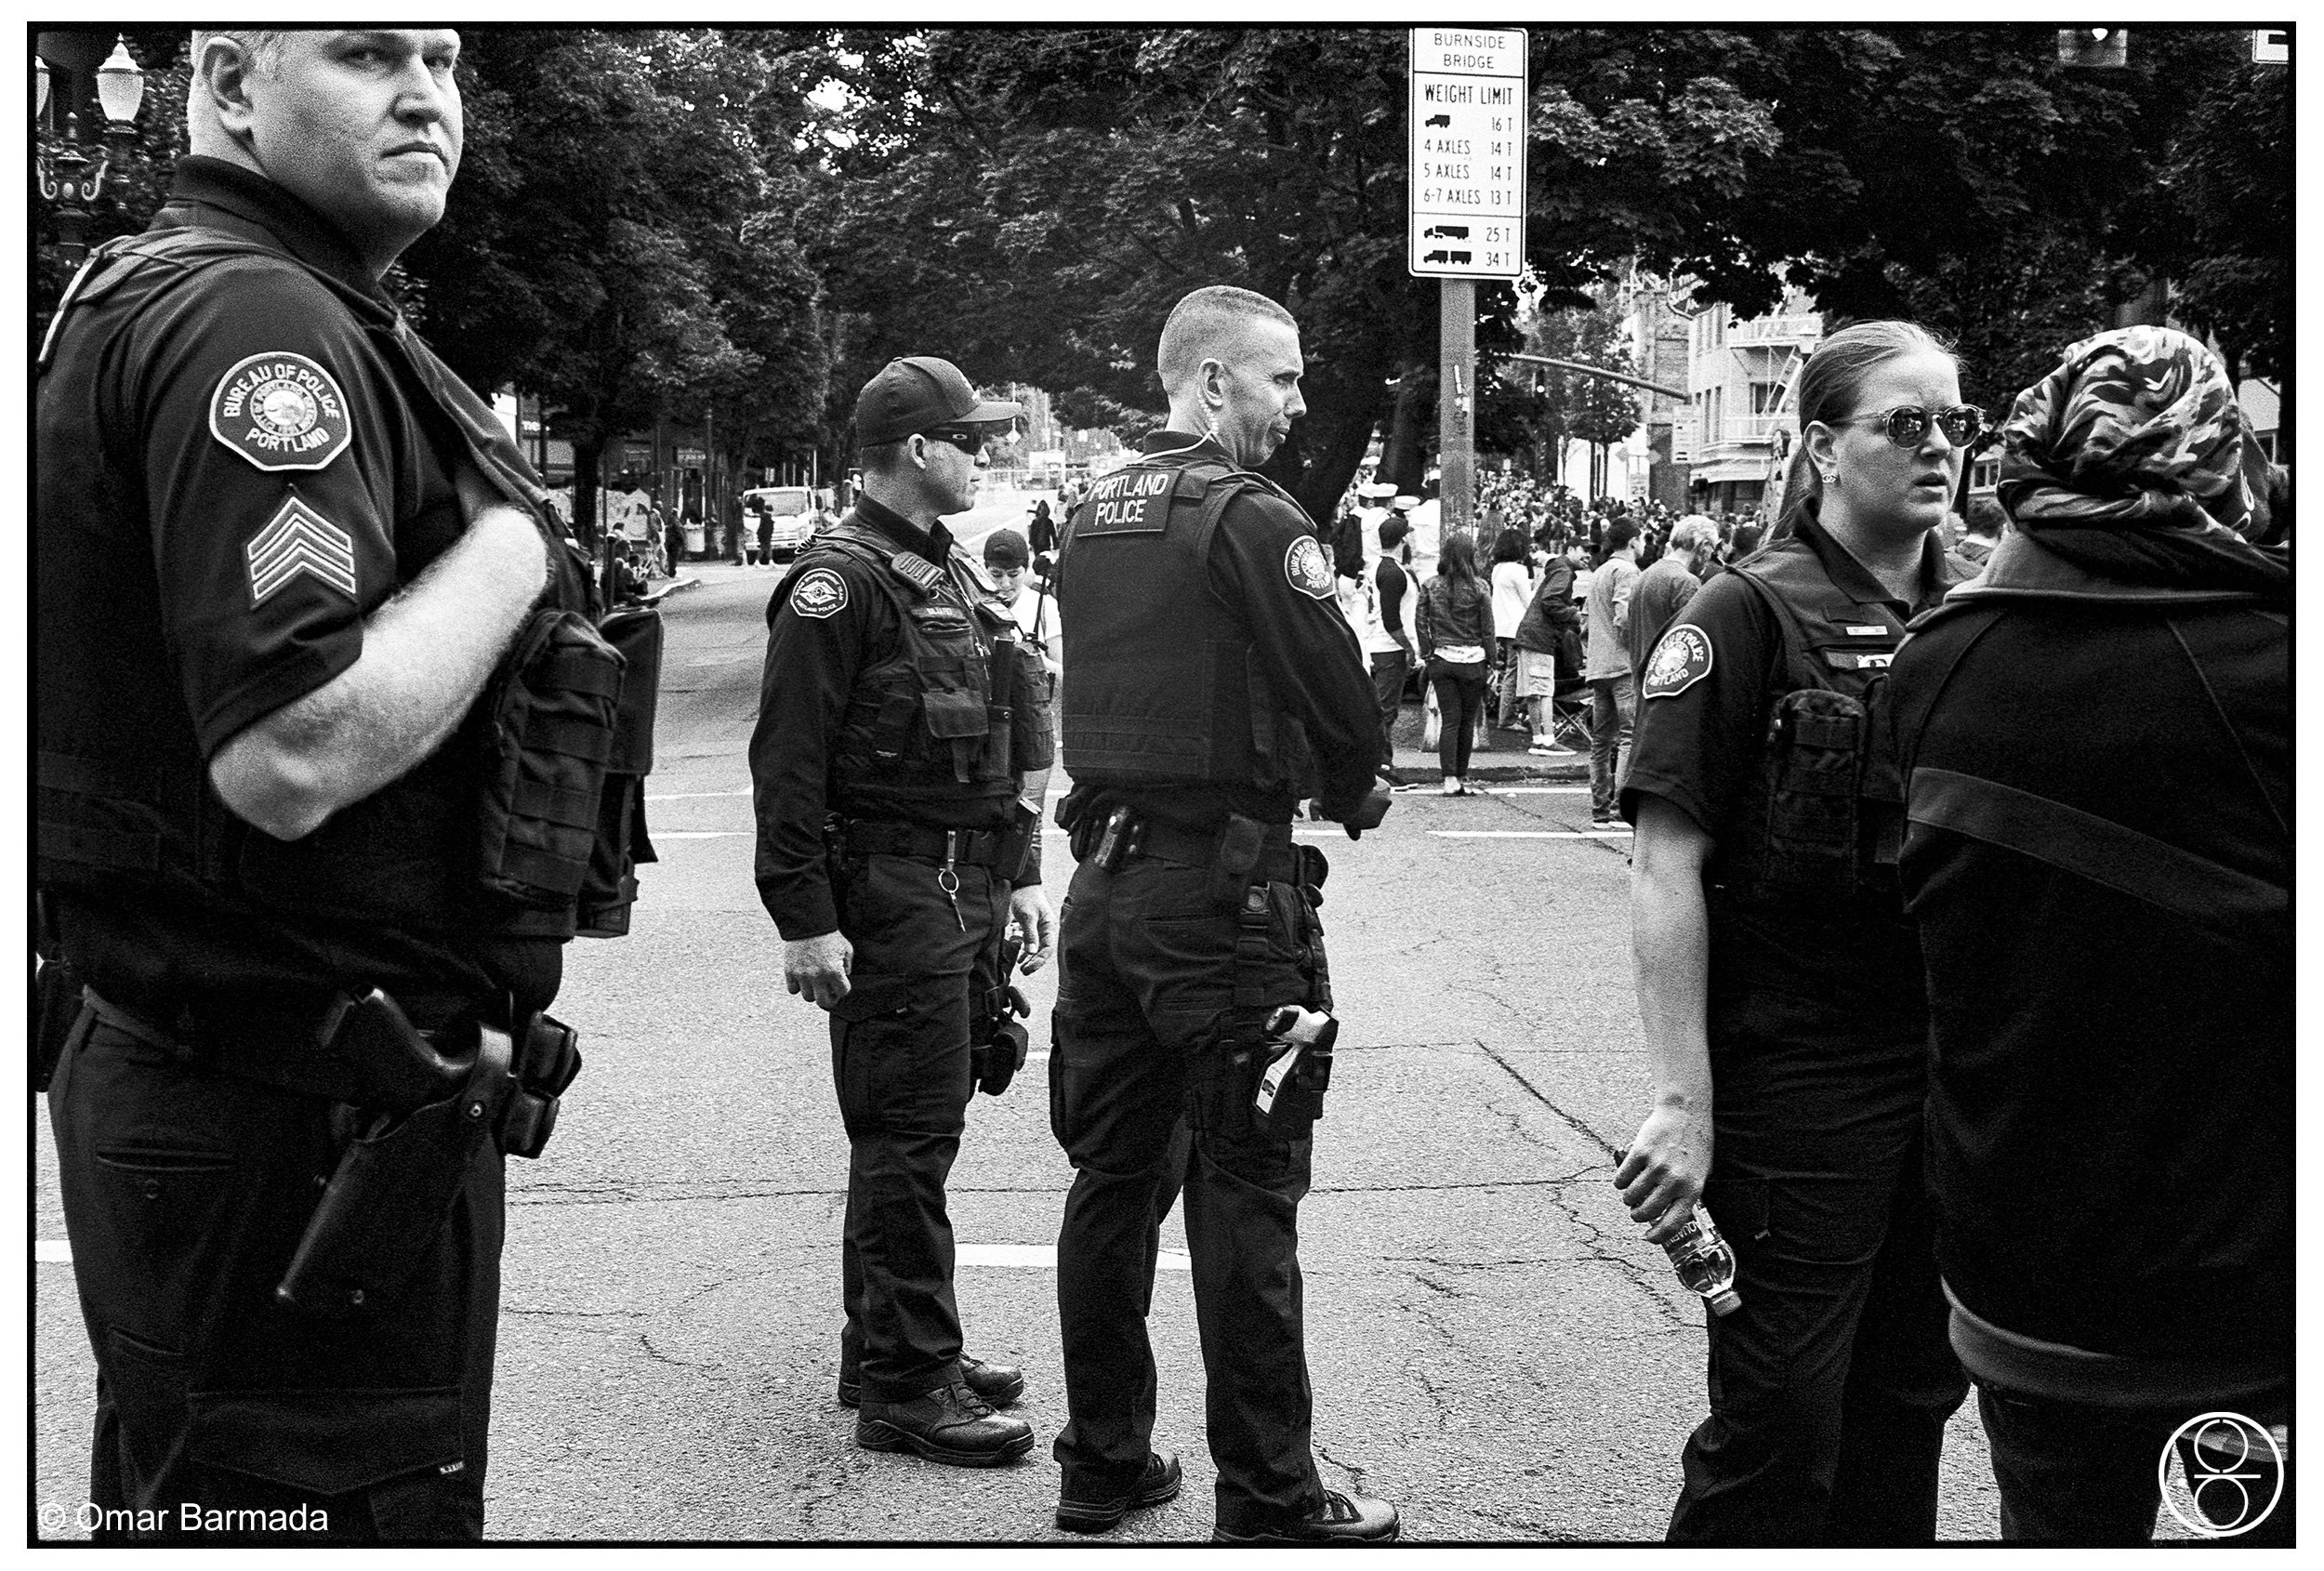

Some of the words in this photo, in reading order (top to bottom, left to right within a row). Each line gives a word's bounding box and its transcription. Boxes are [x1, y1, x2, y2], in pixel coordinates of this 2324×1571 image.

[1433, 33, 1506, 49] BURNSIDE
[1443, 53, 1495, 69] BRIDGE
[1424, 84, 1473, 103] WEIGHT
[1480, 86, 1513, 105] LIMIT
[1491, 116, 1502, 132] 16
[1507, 116, 1512, 132] T
[1424, 139, 1431, 152] 4
[1436, 139, 1471, 155] AXLES
[1490, 141, 1501, 156] 14
[1507, 141, 1512, 156] T
[1423, 163, 1431, 178] 5
[1435, 164, 1470, 179] AXLES
[1490, 165, 1501, 180] 14
[1507, 165, 1512, 180] T
[1423, 188, 1442, 203] 6-7
[1446, 189, 1481, 205] AXLES
[1490, 190, 1501, 205] 13
[1507, 191, 1512, 205] T
[1486, 227, 1499, 243] 25
[1505, 228, 1511, 243] T
[1486, 251, 1499, 267] 34
[1504, 252, 1510, 267] T
[223, 364, 272, 417] BUREAU
[274, 363, 297, 379] OF
[296, 368, 340, 419] POLICE
[244, 427, 330, 453] PORTLAND
[1088, 473, 1169, 502] PORTLAND
[1094, 498, 1148, 526] POLICE
[1683, 632, 1704, 662] POLICE
